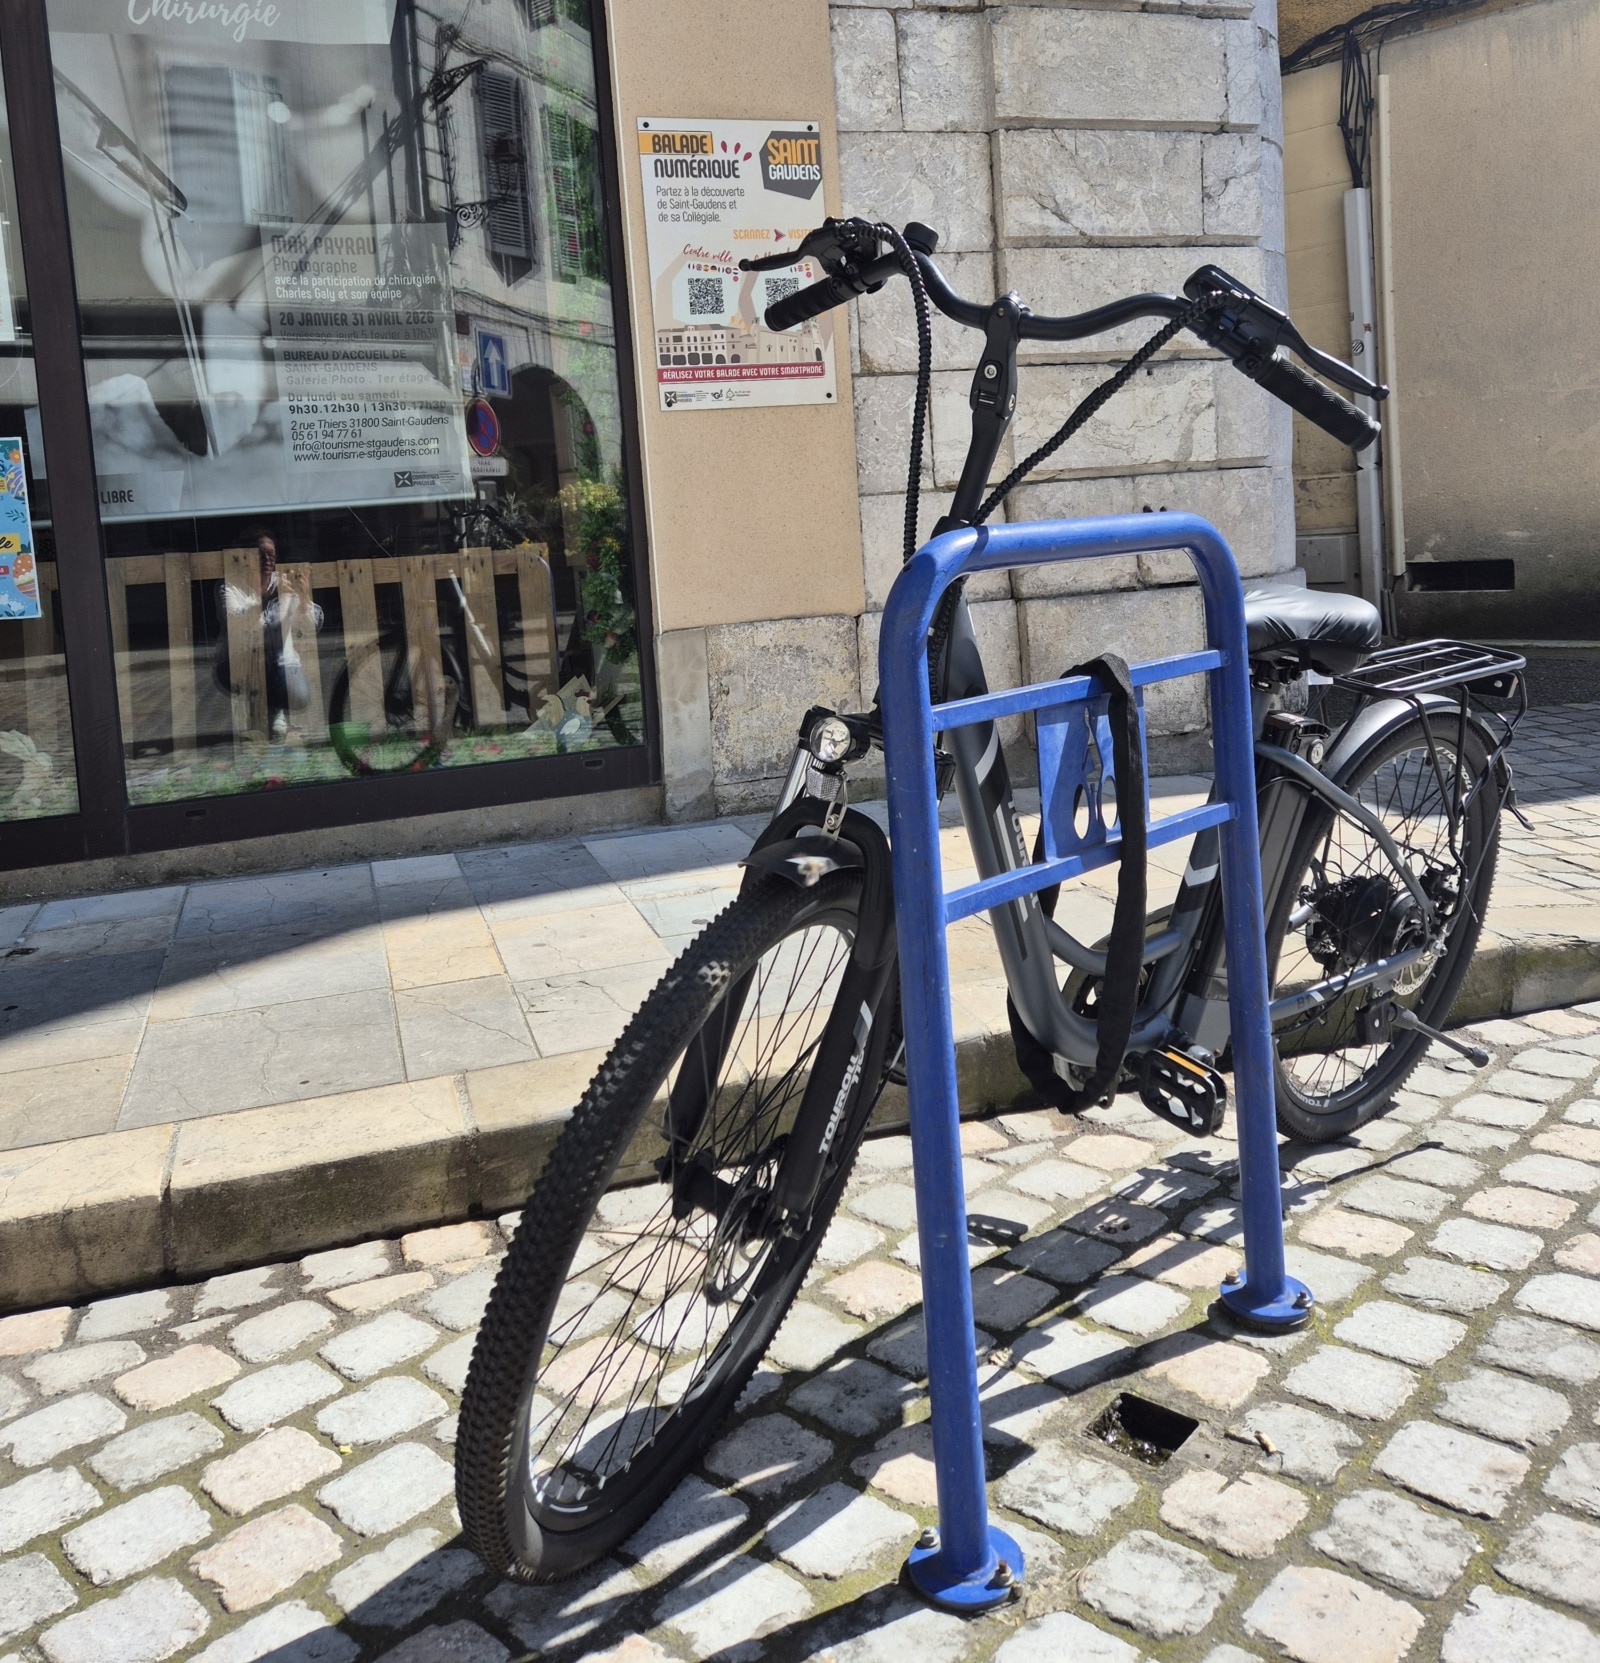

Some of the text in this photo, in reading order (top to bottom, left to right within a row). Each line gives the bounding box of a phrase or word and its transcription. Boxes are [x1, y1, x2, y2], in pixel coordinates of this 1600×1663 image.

[652, 134, 708, 154] BALADE
[767, 138, 819, 164] SAINT
[654, 154, 741, 179] NUMÉRIQUE
[768, 164, 821, 181] GAUDENS
[656, 185, 745, 197] Partez à la découverte
[657, 198, 737, 211] de Saint-Gaudens et
[658, 211, 721, 225] de sa Collégiale.
[733, 229, 770, 240] SCANNEZ
[313, 235, 377, 255] PAYRAU
[683, 243, 733, 263] Centre ville
[273, 256, 357, 277] Photographe
[274, 273, 436, 288] avec la participation du chirurgien
[276, 287, 401, 301] Charles Galy et son équipe
[298, 312, 349, 327] JANVIER
[352, 312, 364, 326] 31
[368, 311, 402, 326] AVRIL
[283, 350, 407, 361] BUREAU D'ACCUEIL DE
[285, 362, 378, 373] SAINT-GAUDENS
[663, 364, 823, 380] RÉALISEZ VOTRE BALADE AVEC VOTRE SMARTPHONE
[331, 374, 365, 384] Photo
[377, 374, 395, 383] 1er
[288, 393, 302, 402] Du
[307, 392, 336, 402] lundi
[340, 393, 354, 401] au
[358, 390, 400, 400] samedi
[289, 403, 360, 415] 9h30.12h30
[372, 401, 447, 412] 13h30.17h30
[291, 416, 449, 431] 2 rue Thiers 31800 Saint-Gaudens
[292, 429, 362, 441] 05 61 94 77 61
[292, 437, 439, 453] info@tourisme-stgaudens.com
[294, 447, 440, 462] www.tourisme-stgaudens.com
[101, 489, 134, 504] LIBRE
[818, 1053, 861, 1154] TOUROLL
